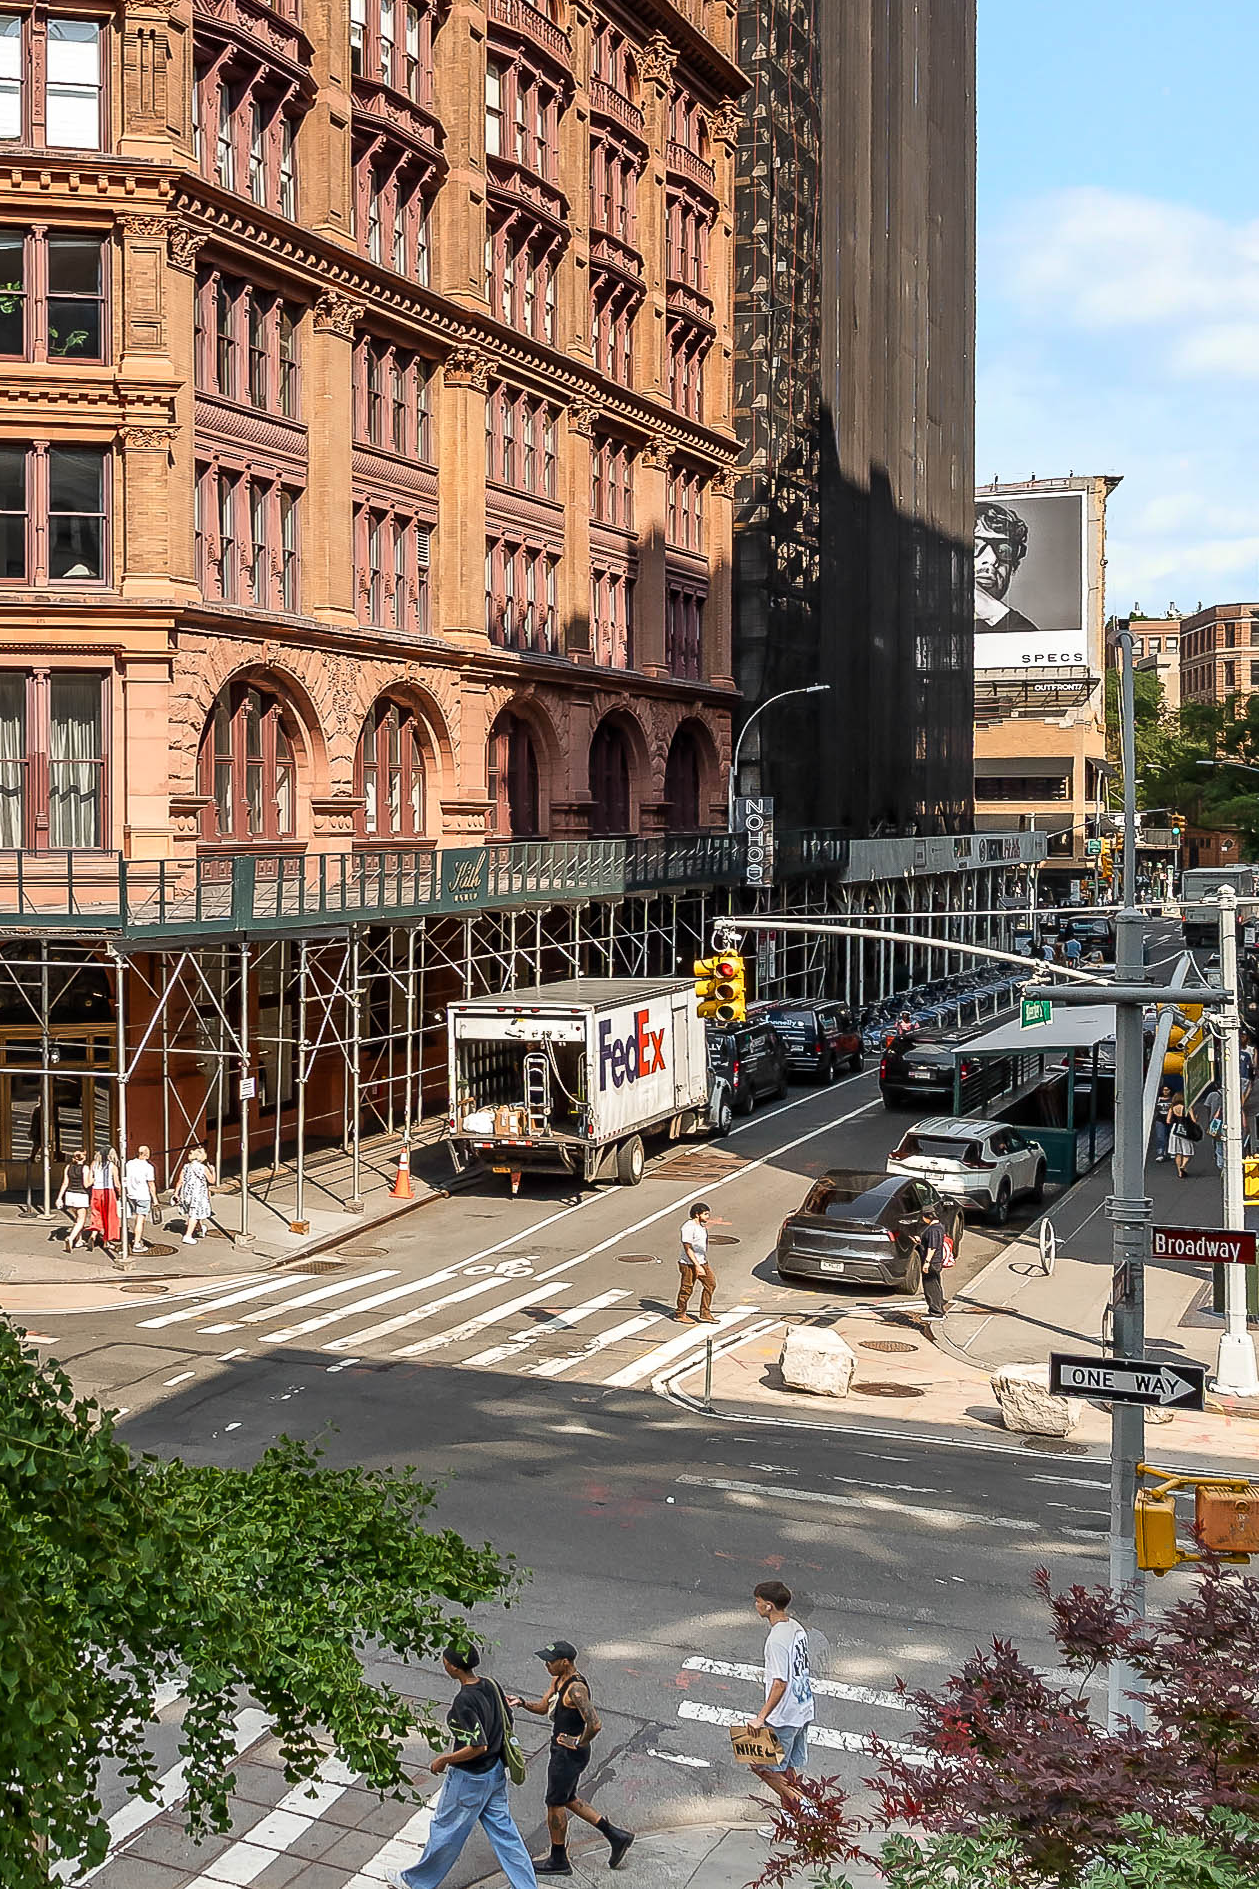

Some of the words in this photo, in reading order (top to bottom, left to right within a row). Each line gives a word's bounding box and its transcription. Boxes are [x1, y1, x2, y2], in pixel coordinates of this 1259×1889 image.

[1021, 653, 1083, 663] SPECS
[745, 798, 764, 863] NOHO
[599, 1008, 666, 1092] FedEx
[1155, 1233, 1241, 1263] Broadway
[1072, 1368, 1115, 1389] ONE
[1135, 1374, 1180, 1395] WAY
[735, 1743, 764, 1758] NIKE
